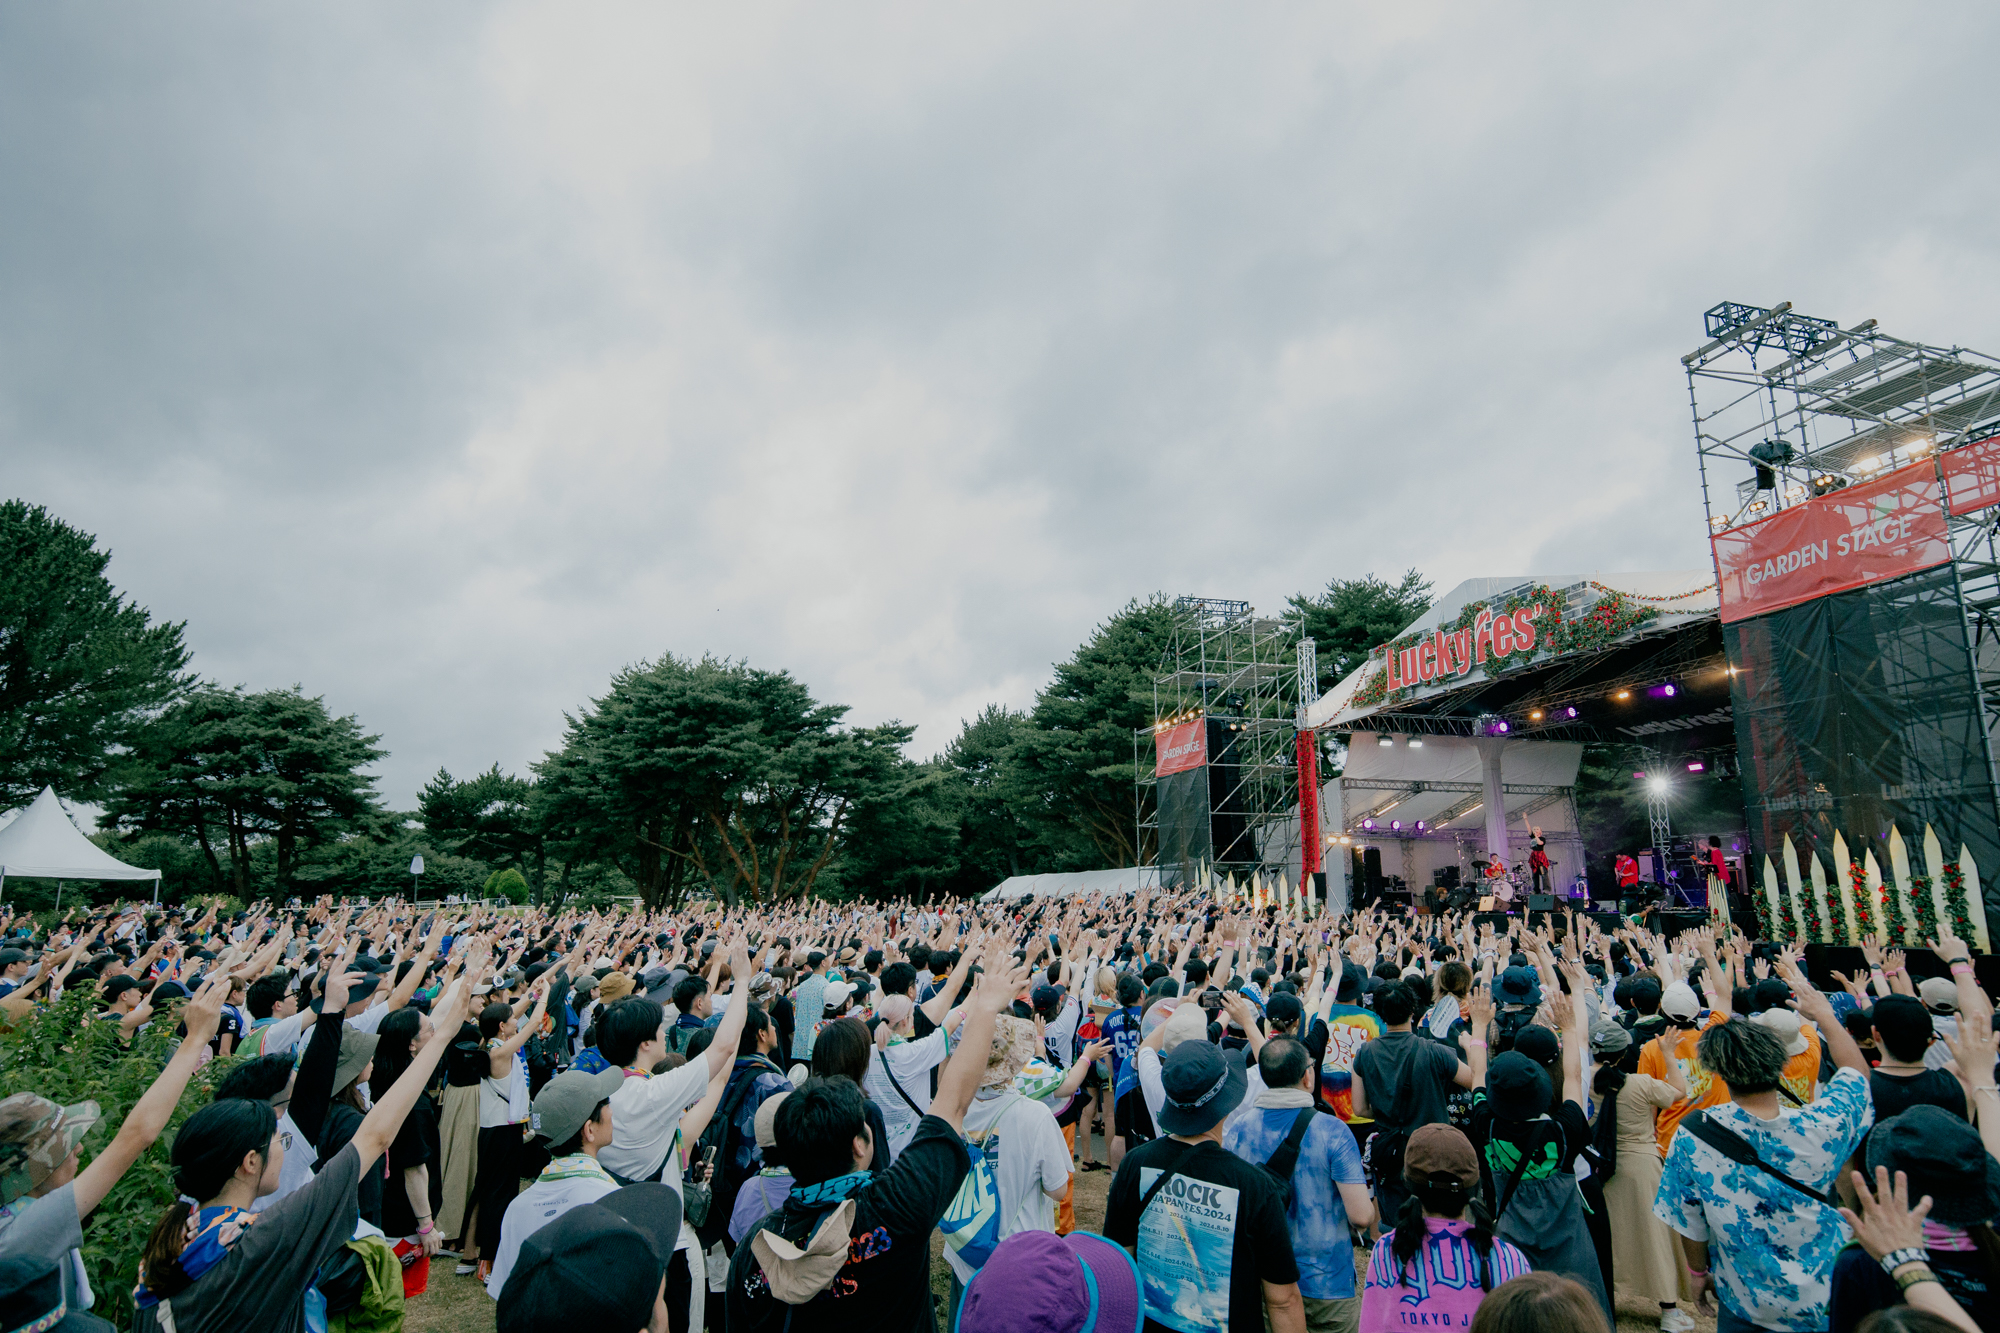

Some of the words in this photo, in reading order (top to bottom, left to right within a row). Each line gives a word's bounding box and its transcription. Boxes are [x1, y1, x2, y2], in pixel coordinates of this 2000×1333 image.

[1746, 539, 1829, 585] GARDEN
[1836, 515, 1912, 556] STAGE
[228, 1019, 236, 1030] 3
[1114, 1030, 1140, 1058] 63
[942, 1156, 996, 1223] IKE
[1199, 1221, 1230, 1233] 2024.8.10
[848, 1226, 892, 1263] 023
[1401, 1312, 1451, 1326] TOKYO
